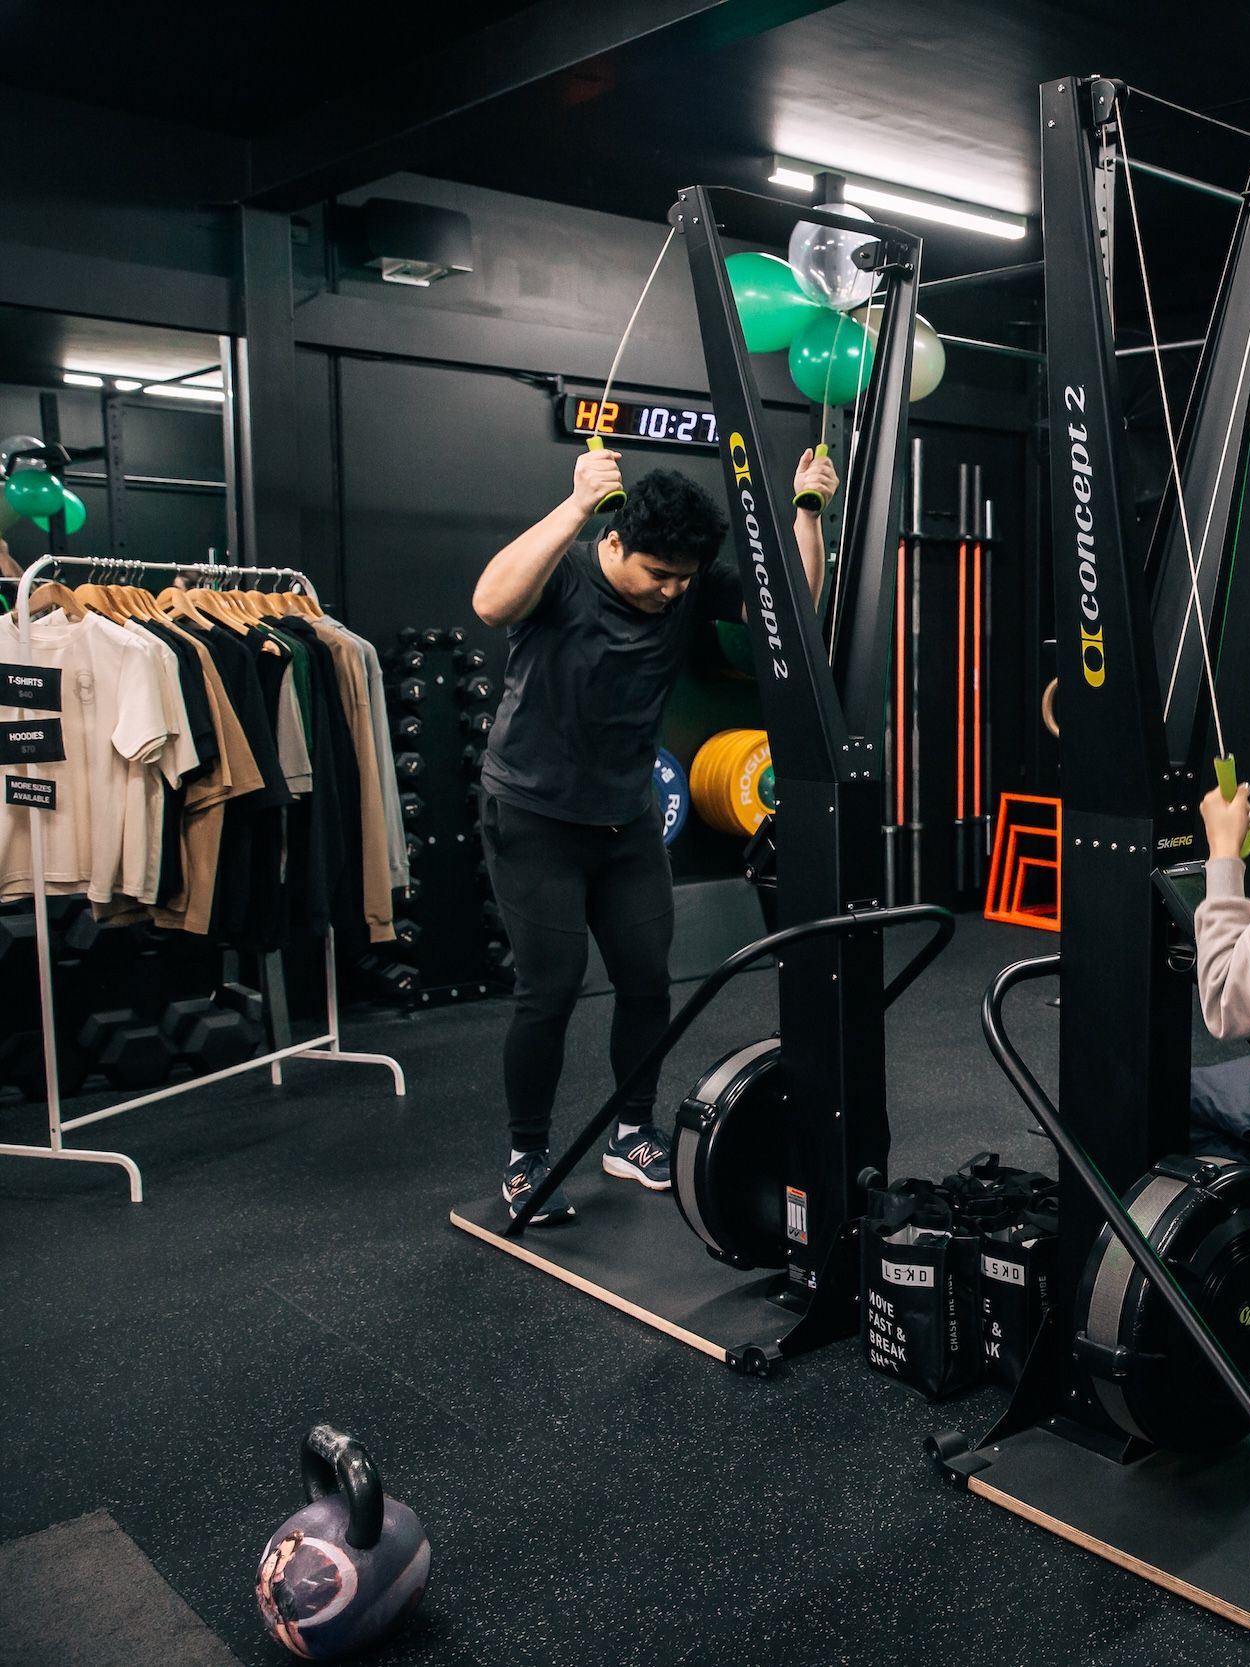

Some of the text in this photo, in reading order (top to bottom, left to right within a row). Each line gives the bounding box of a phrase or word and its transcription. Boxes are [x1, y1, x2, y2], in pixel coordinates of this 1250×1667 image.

[1067, 422, 1099, 621] concept
[741, 489, 783, 651] concept
[8, 675, 44, 688] T-SHIRTS
[9, 731, 44, 742] HOODIES
[10, 781, 52, 794] MORE SIZES
[13, 792, 50, 804] AVAILABLE
[1156, 834, 1194, 850] SkiERG
[869, 1308, 906, 1343] FAST &
[991, 1321, 1002, 1338] &
[869, 1328, 907, 1362] BREAK
